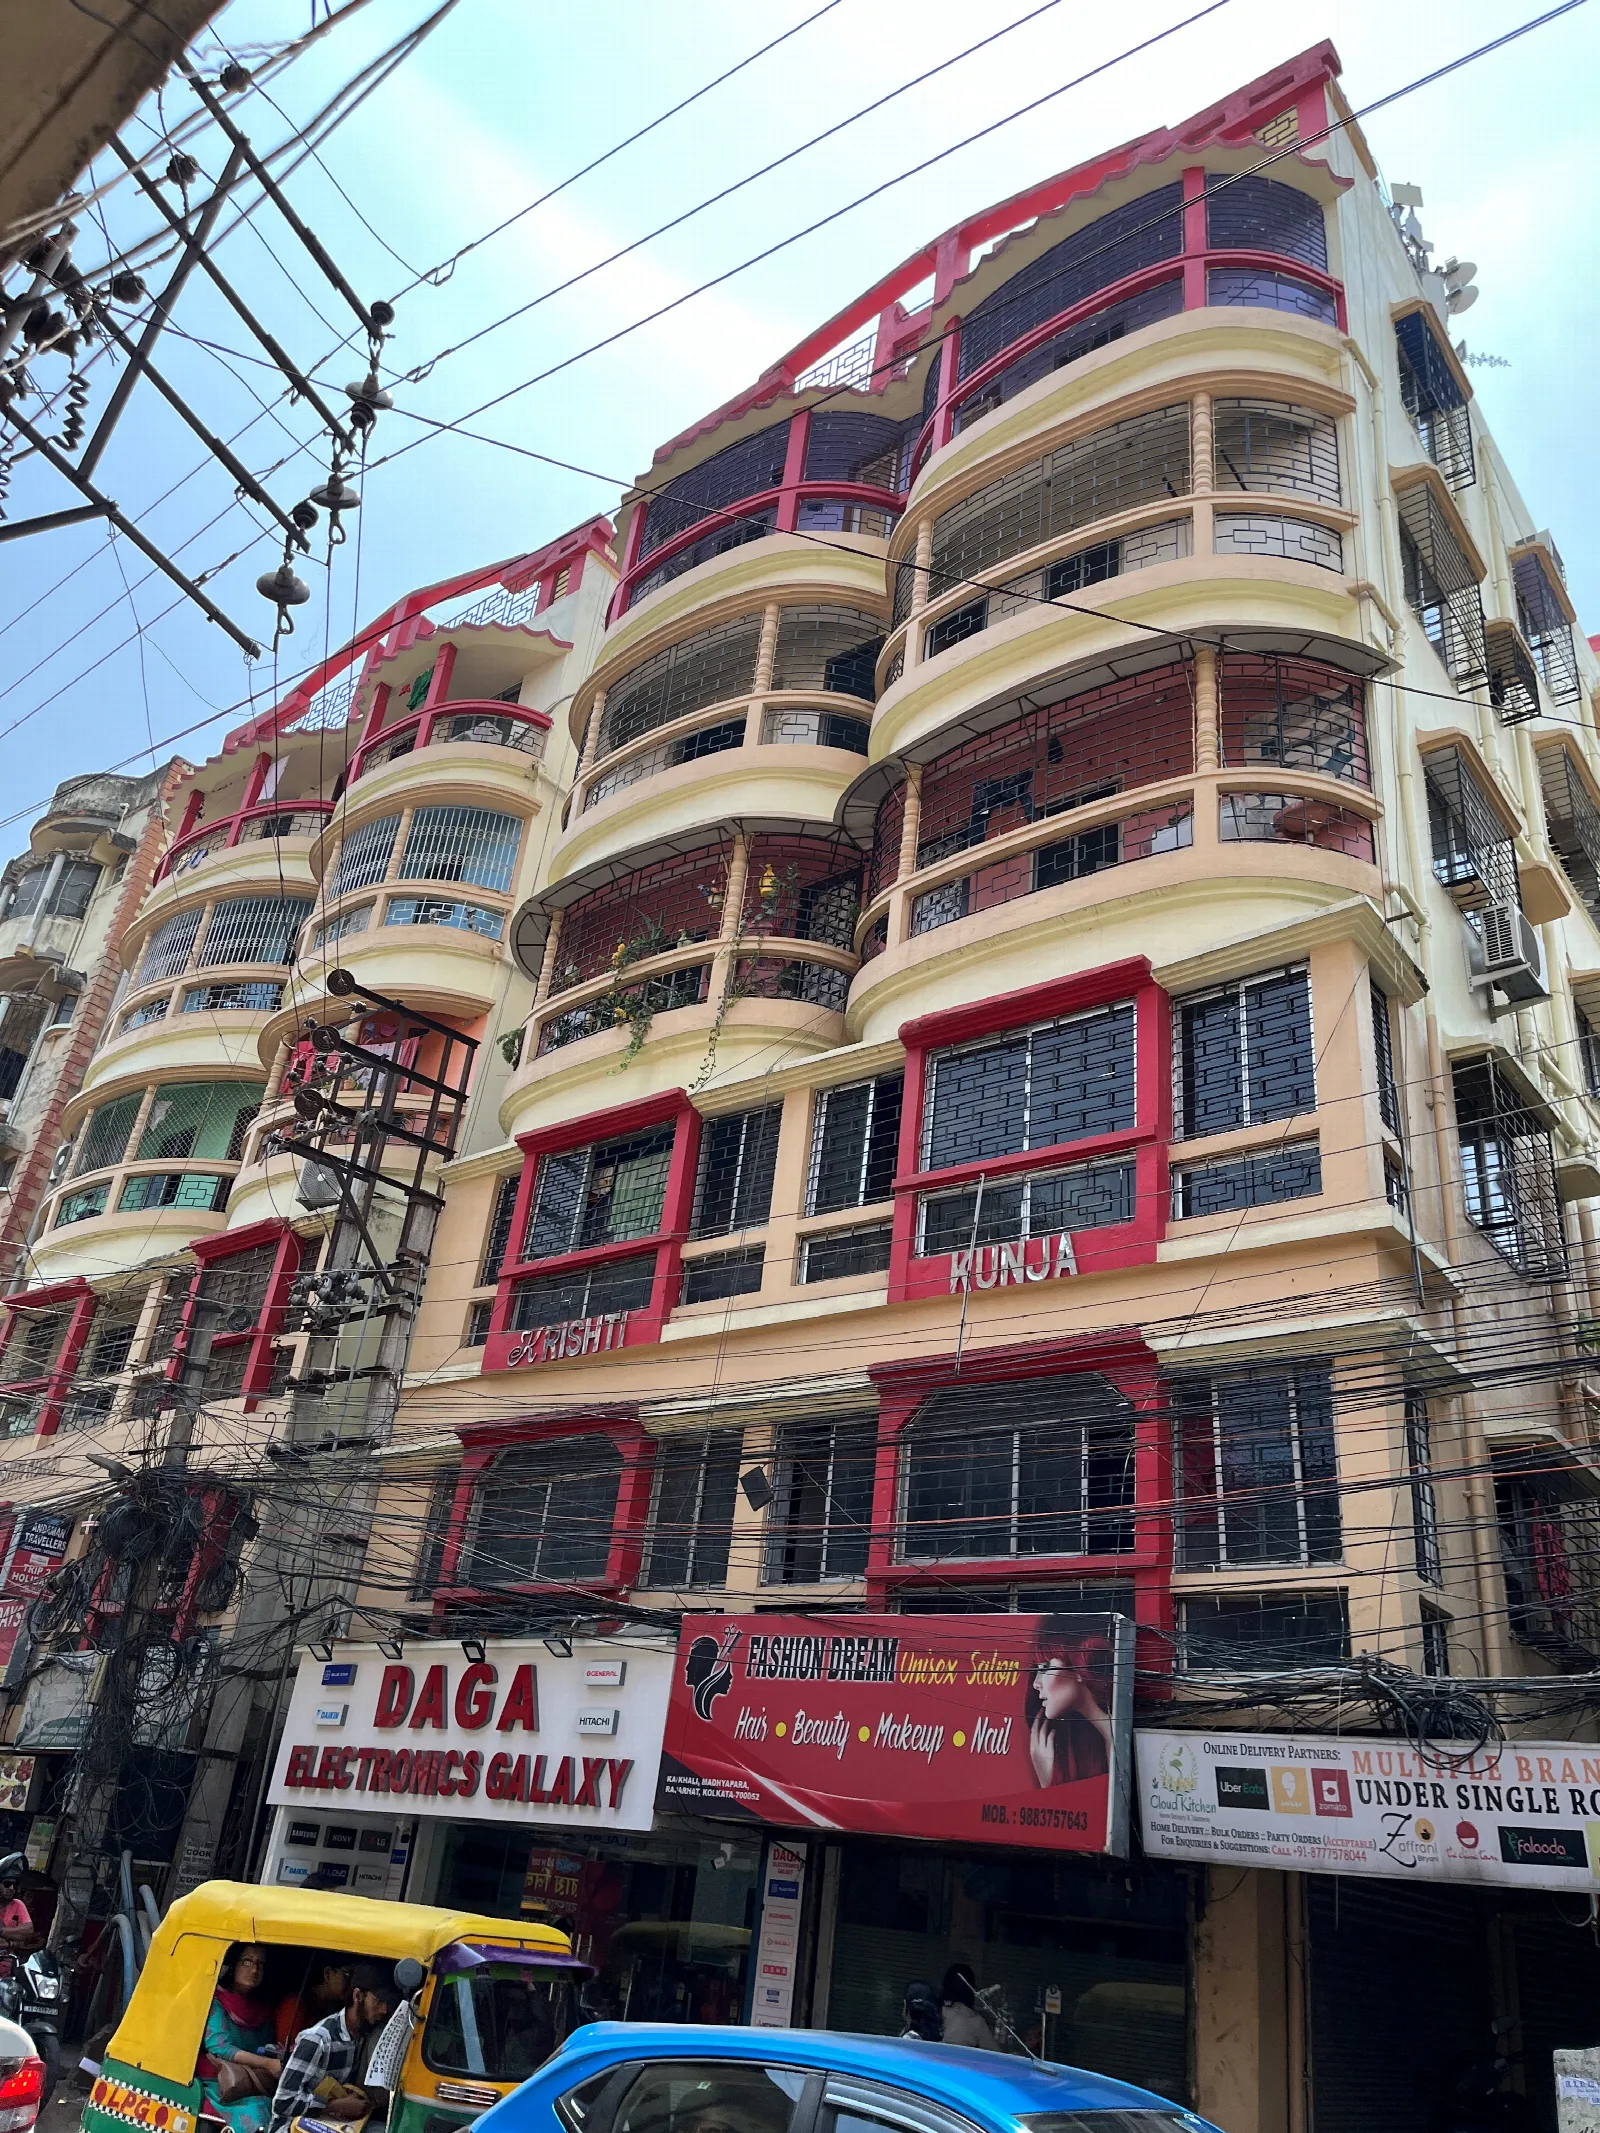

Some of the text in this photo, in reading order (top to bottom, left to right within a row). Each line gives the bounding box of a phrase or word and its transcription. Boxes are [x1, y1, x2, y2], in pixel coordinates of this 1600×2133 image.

[950, 1231, 1078, 1294] KUNJA
[507, 1310, 629, 1367] KRISHTI
[25, 1532, 67, 1551] TRAVELLERS
[23, 1564, 44, 1576] TRIP
[0, 1604, 24, 1627] AYS
[746, 1636, 1020, 1687] FASHION DREAM Unisex Salon
[373, 1663, 540, 1732] DAGA
[579, 1717, 610, 1726] HITACHI
[734, 1706, 1012, 1764] Hair Beauty Makeup Nail
[1203, 1742, 1341, 1761] ONLINE DELIVERY PARTNERS:
[284, 1744, 634, 1810] ELECTRONICS GALAXY
[1353, 1751, 1502, 1781] MULTIPLE
[1220, 1781, 1265, 1794] Uber Eats
[1356, 1779, 1449, 1809] UNDER
[1456, 1784, 1560, 1815] SINGLE
[1150, 1794, 1217, 1814] Cloud Kitchen
[1319, 1803, 1348, 1812] zomato
[981, 1804, 1010, 1824] MOB.
[1020, 1807, 1088, 1831] 9883757643
[291, 1829, 318, 1839] SAMSUNG
[332, 1834, 353, 1843] SONY
[376, 1837, 386, 1847] LG
[1150, 1821, 1171, 1832] HOME
[1211, 1827, 1229, 1838] BULK
[1231, 1828, 1260, 1840] ORDERS
[1266, 1831, 1290, 1842] PARTY
[1292, 1833, 1321, 1845] ORDERS
[1323, 1835, 1377, 1851] (ACCEPTABLE)
[1161, 1834, 1175, 1845] FOR
[1175, 1836, 1212, 1849] ENQUIRIES
[1213, 1841, 1219, 1849] &
[1220, 1840, 1271, 1854] SUGGESTIONS:
[1272, 1845, 1291, 1856] CALL
[773, 1848, 801, 1863] DAGA
[358, 1873, 383, 1881] HITACHI
[107, 2086, 151, 2121] LPG
